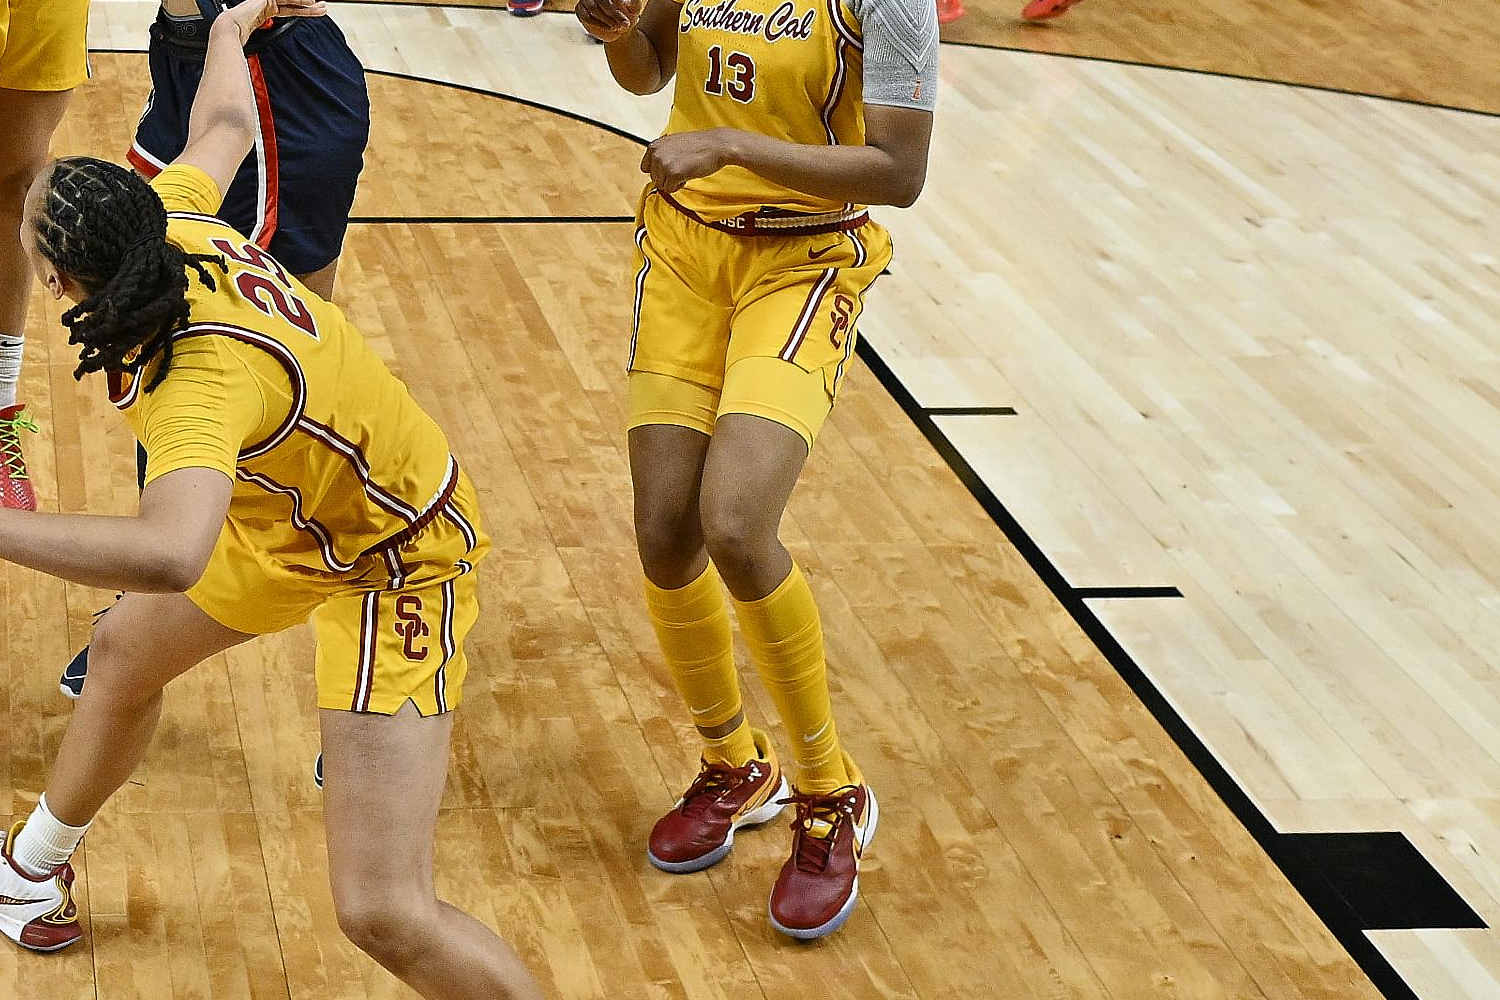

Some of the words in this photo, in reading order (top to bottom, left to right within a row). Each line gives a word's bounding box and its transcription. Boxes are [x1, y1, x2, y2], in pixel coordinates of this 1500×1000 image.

[764, 0, 817, 43] Cal
[704, 44, 756, 105] 13
[394, 594, 430, 662] SC
